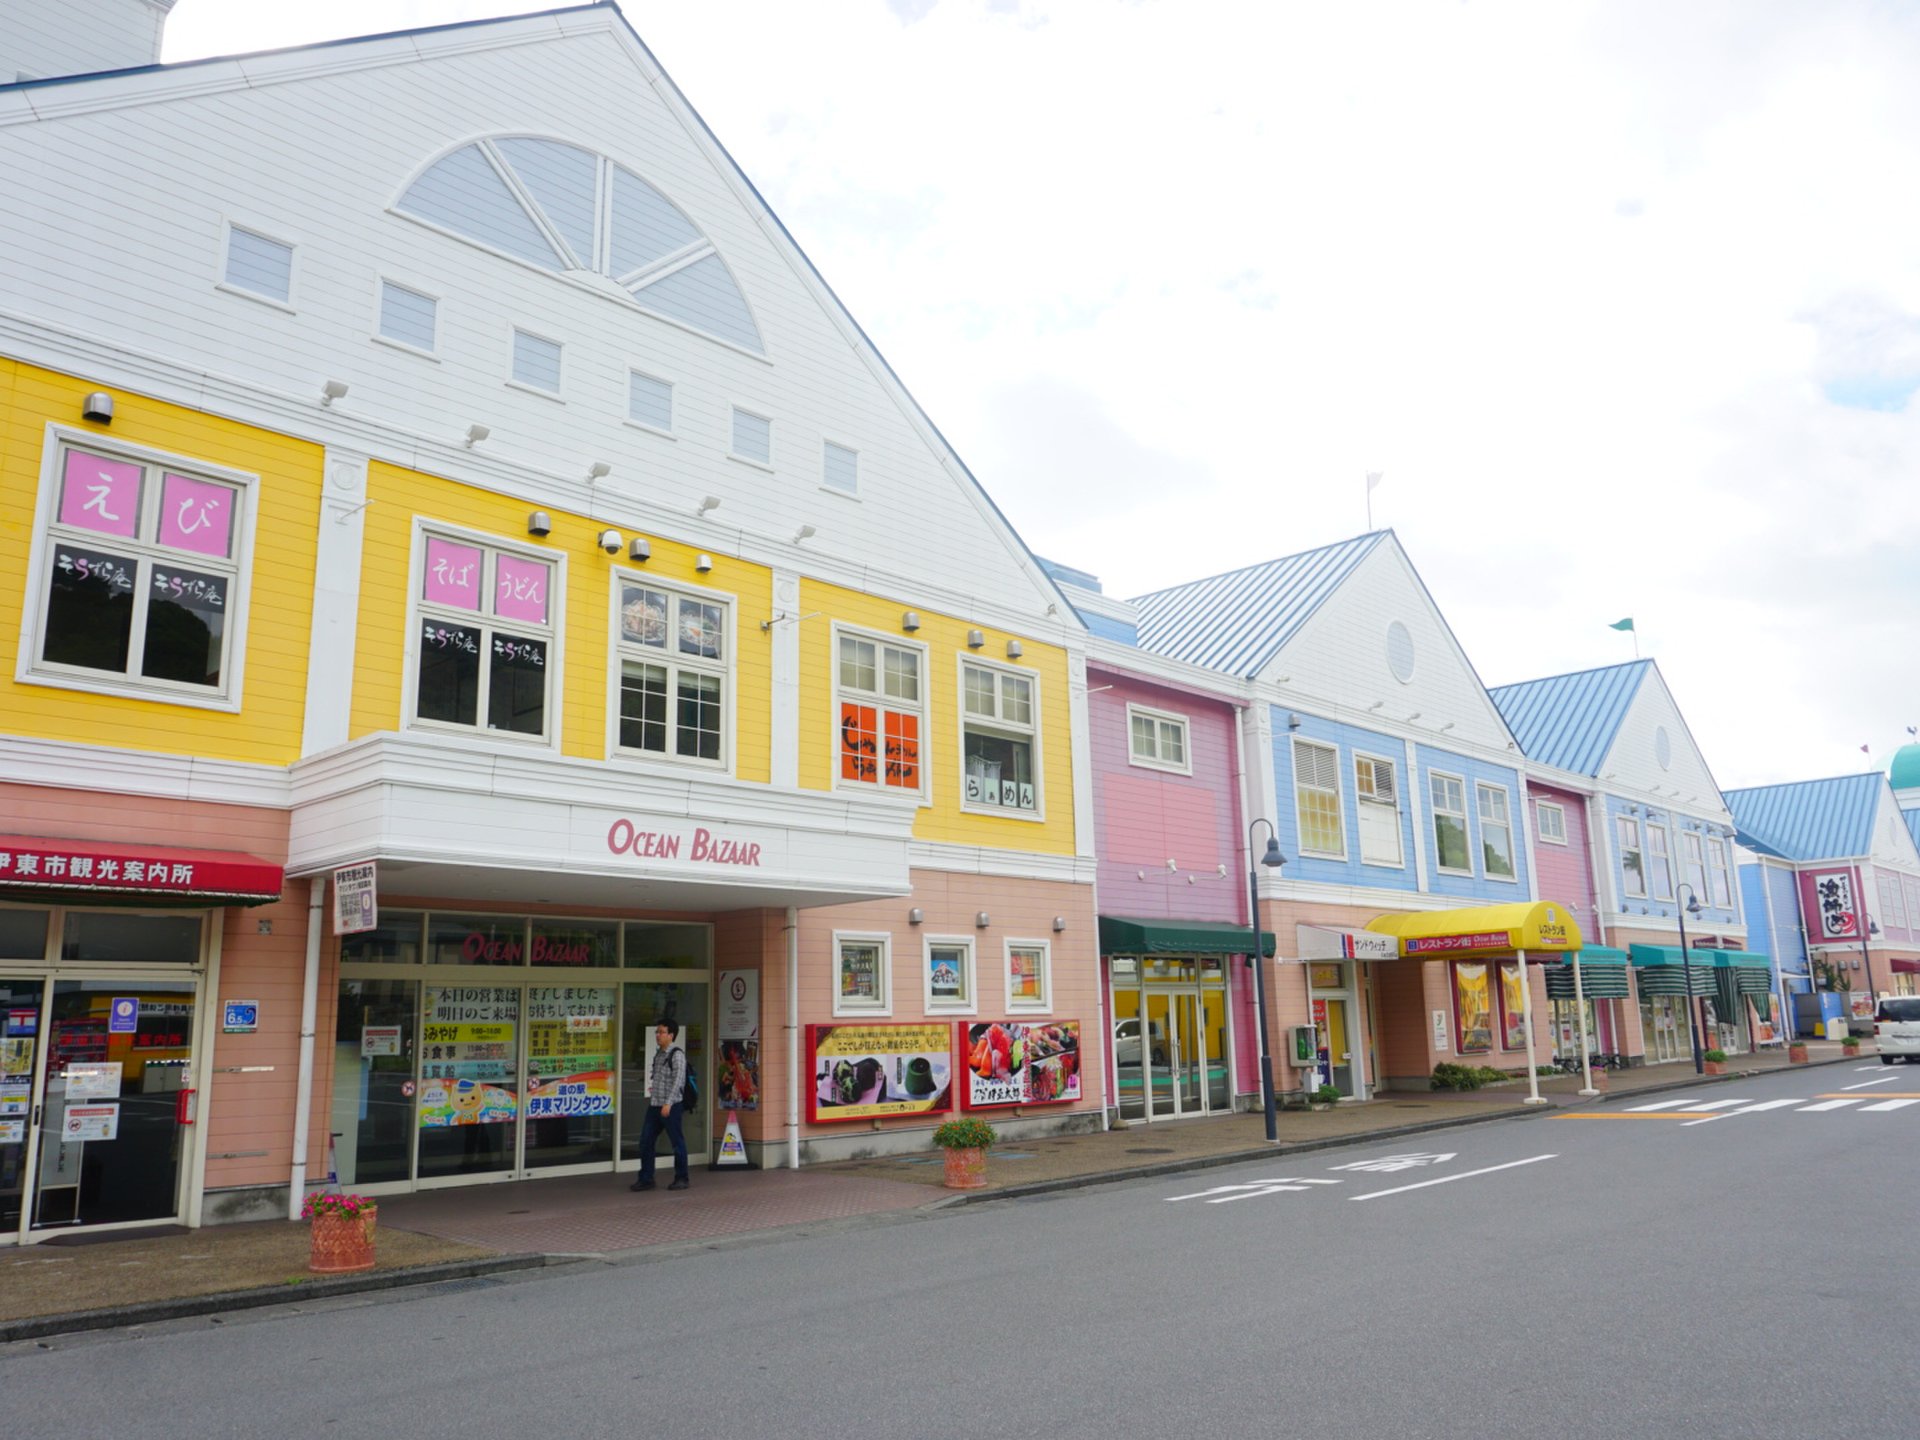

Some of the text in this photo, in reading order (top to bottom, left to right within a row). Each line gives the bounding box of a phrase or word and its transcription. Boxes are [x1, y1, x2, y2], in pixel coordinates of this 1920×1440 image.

[432, 558, 475, 588] そば
[500, 572, 544, 604] うどん
[607, 818, 761, 867] OCEAN BAZAAR
[531, 934, 590, 962] BAZAAR
[1419, 936, 1472, 949] レストラン街
[439, 988, 518, 1003] 本日の営業は
[558, 1084, 586, 1095] 道の駅
[529, 1096, 612, 1115] 伊東マリンタウン
